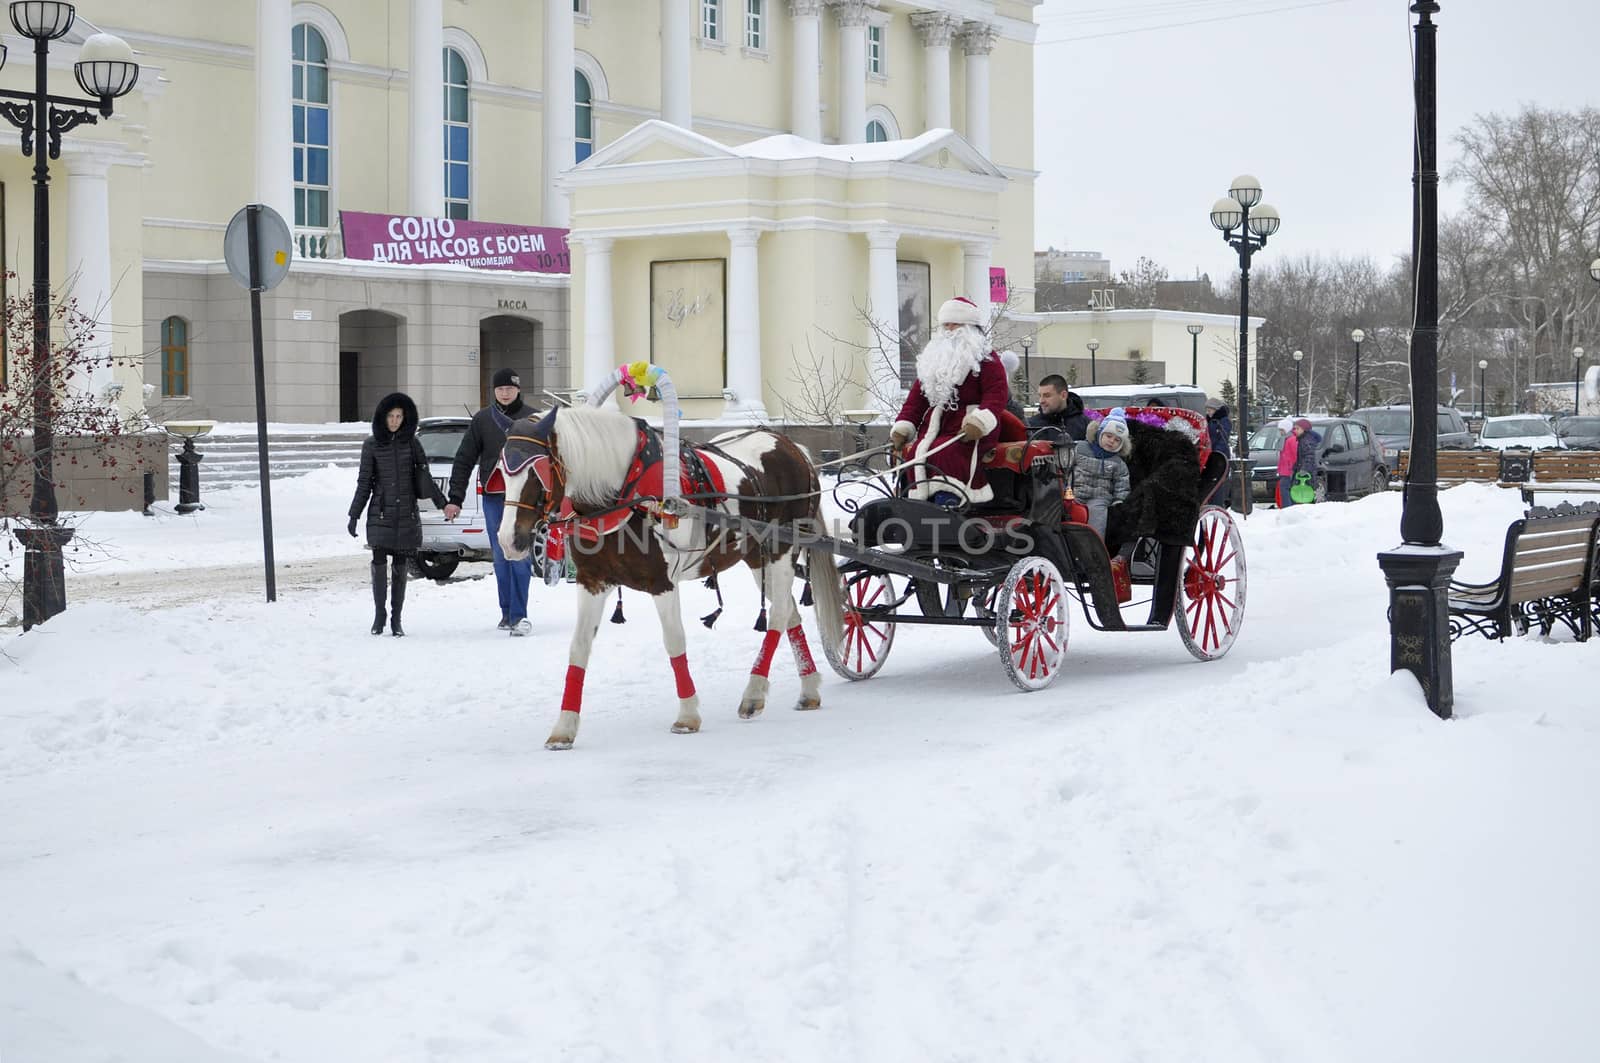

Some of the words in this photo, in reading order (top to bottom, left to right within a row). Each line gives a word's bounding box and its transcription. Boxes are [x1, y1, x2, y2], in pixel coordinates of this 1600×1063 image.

[388, 216, 456, 241] СОЛО
[373, 241, 413, 263] ДЛЯ
[414, 237, 480, 260] ЧАСОВ
[482, 236, 495, 255] С
[495, 233, 546, 254] БОЕМ
[497, 299, 528, 311] КАССА
